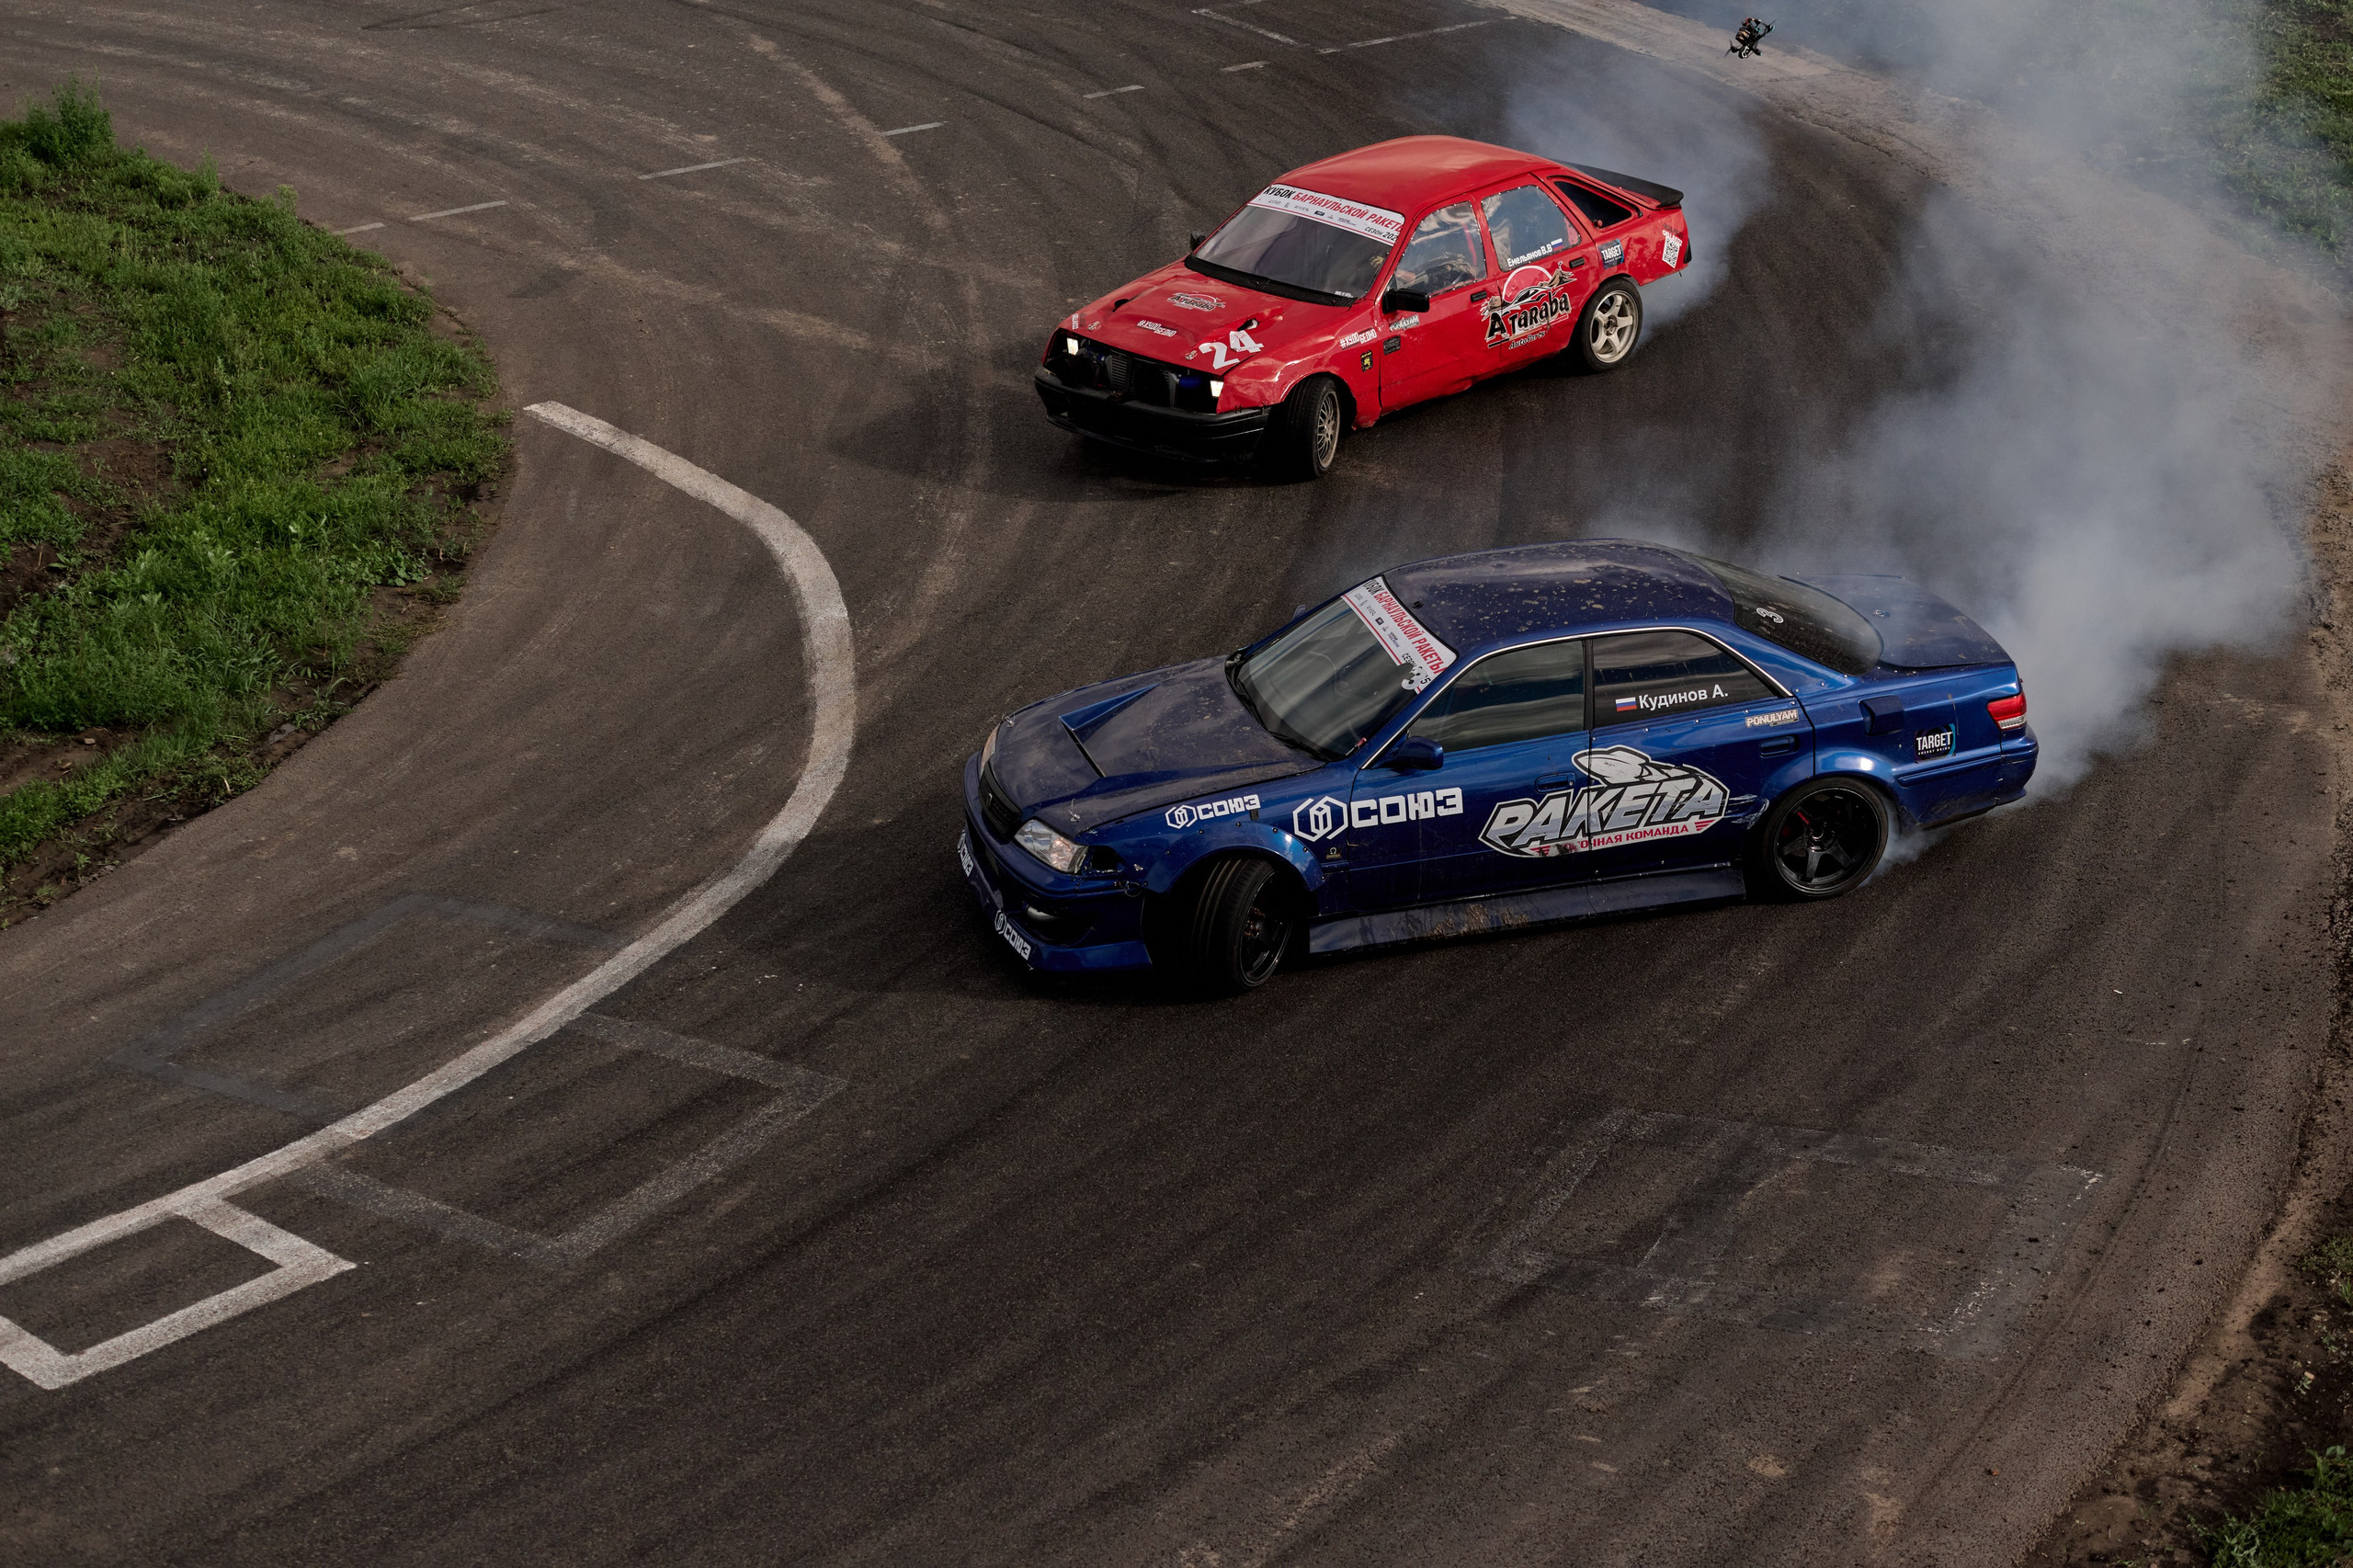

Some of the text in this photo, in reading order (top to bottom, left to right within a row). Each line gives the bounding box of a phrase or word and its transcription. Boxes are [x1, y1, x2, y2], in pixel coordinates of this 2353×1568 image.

[1263, 186, 1296, 199] КУБОК
[1291, 192, 1370, 219] БАРНАУЛЬСКОЙ
[1364, 226, 1398, 242] СЕЗОН 202
[1507, 249, 1542, 267] Емельянов
[1600, 244, 1621, 261] TARGET
[1199, 329, 1265, 369] 24
[1756, 608, 1784, 624] 3
[1373, 591, 1426, 641] БАРНАУЛЬСКОЙ
[1412, 637, 1449, 675] РАКЕТЫ
[1638, 684, 1729, 711] Кудинов А.
[1746, 710, 1798, 727] PONULYAM
[1915, 731, 1953, 751] TARGET
[1196, 793, 1261, 821] СОЮЗ
[1349, 786, 1464, 829] СОЮЗ
[1483, 777, 1725, 849] РАКЕТА
[1625, 824, 1689, 845] КОМАНДА
[1003, 921, 1032, 960] СОЮЗ
